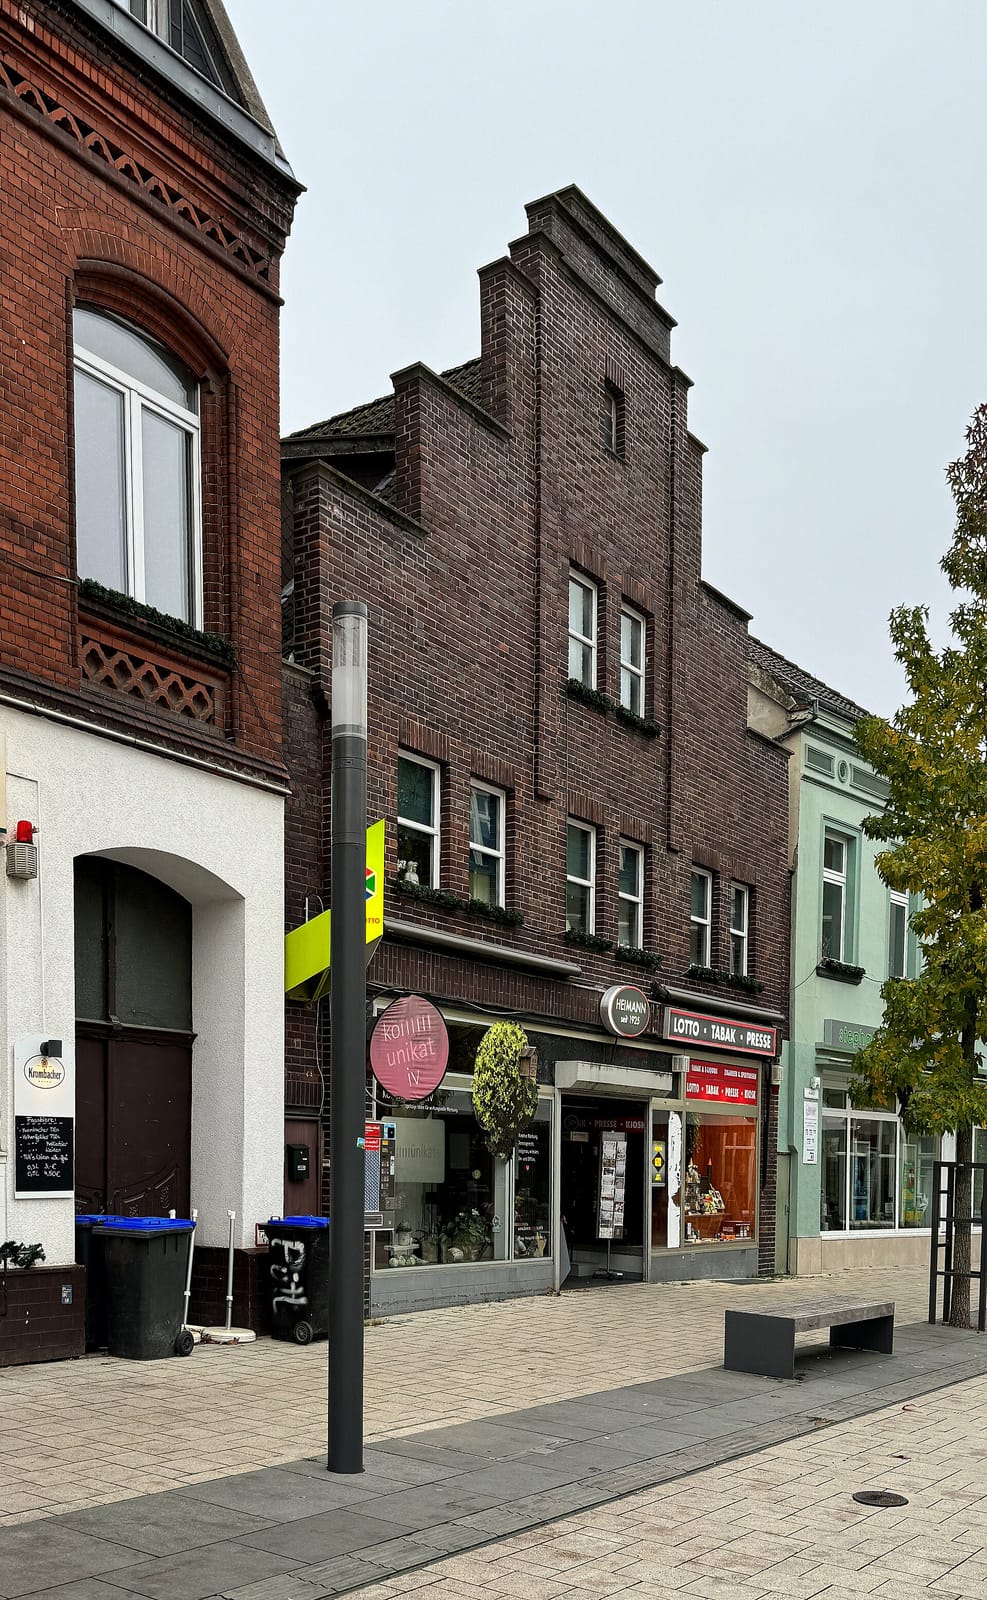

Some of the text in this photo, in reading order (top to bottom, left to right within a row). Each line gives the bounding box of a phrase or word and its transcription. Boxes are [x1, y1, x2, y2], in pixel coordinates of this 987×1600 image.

[366, 917, 380, 925] TTO
[616, 998, 646, 1014] HEIMANN
[620, 1014, 641, 1025] seit 1925
[673, 1017, 772, 1049] LOTTO TABAK PRESSE
[386, 1037, 436, 1067] unikat
[28, 1066, 62, 1080] Krombacher
[406, 1067, 420, 1088] iv
[686, 1082, 756, 1100] LOTTO TABAK PRESSE KIOSK
[594, 1120, 617, 1128] PRESSE
